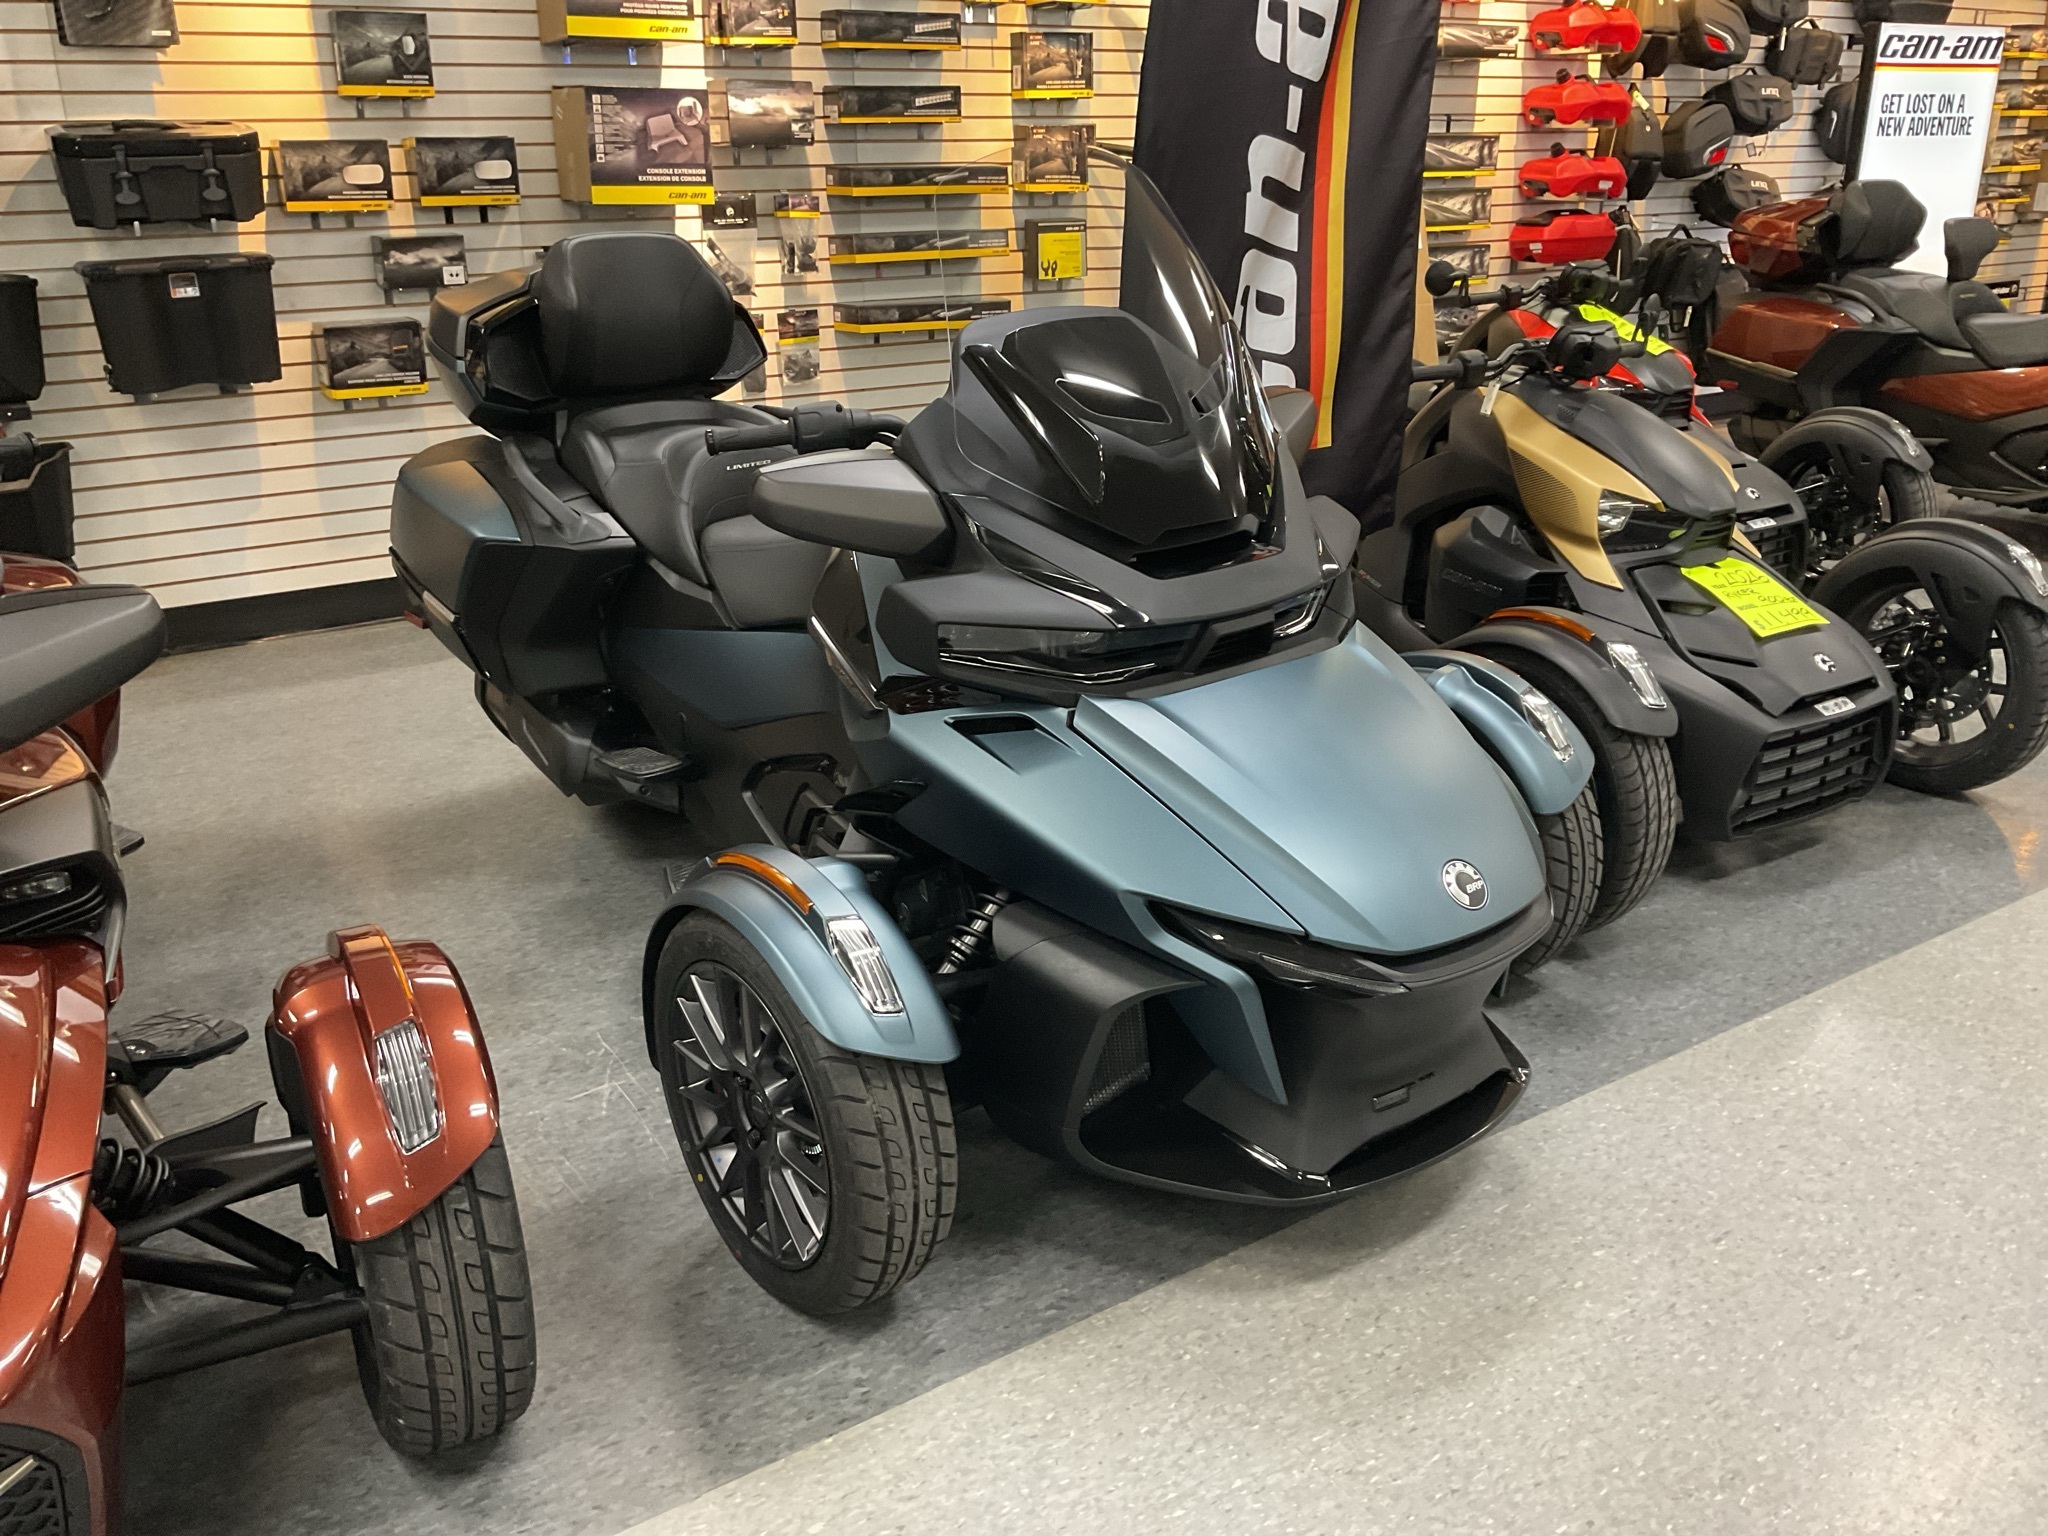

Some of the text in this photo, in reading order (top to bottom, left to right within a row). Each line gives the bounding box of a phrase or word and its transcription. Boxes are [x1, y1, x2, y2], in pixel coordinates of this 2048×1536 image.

[1879, 34, 2005, 60] can-am
[1881, 93, 1966, 114] GET LOST ON A
[1877, 115, 1974, 137] NEW ADVENTURE
[668, 192, 707, 200] can-am
[726, 459, 771, 471] LIMITED
[1466, 880, 1484, 894] BRP
